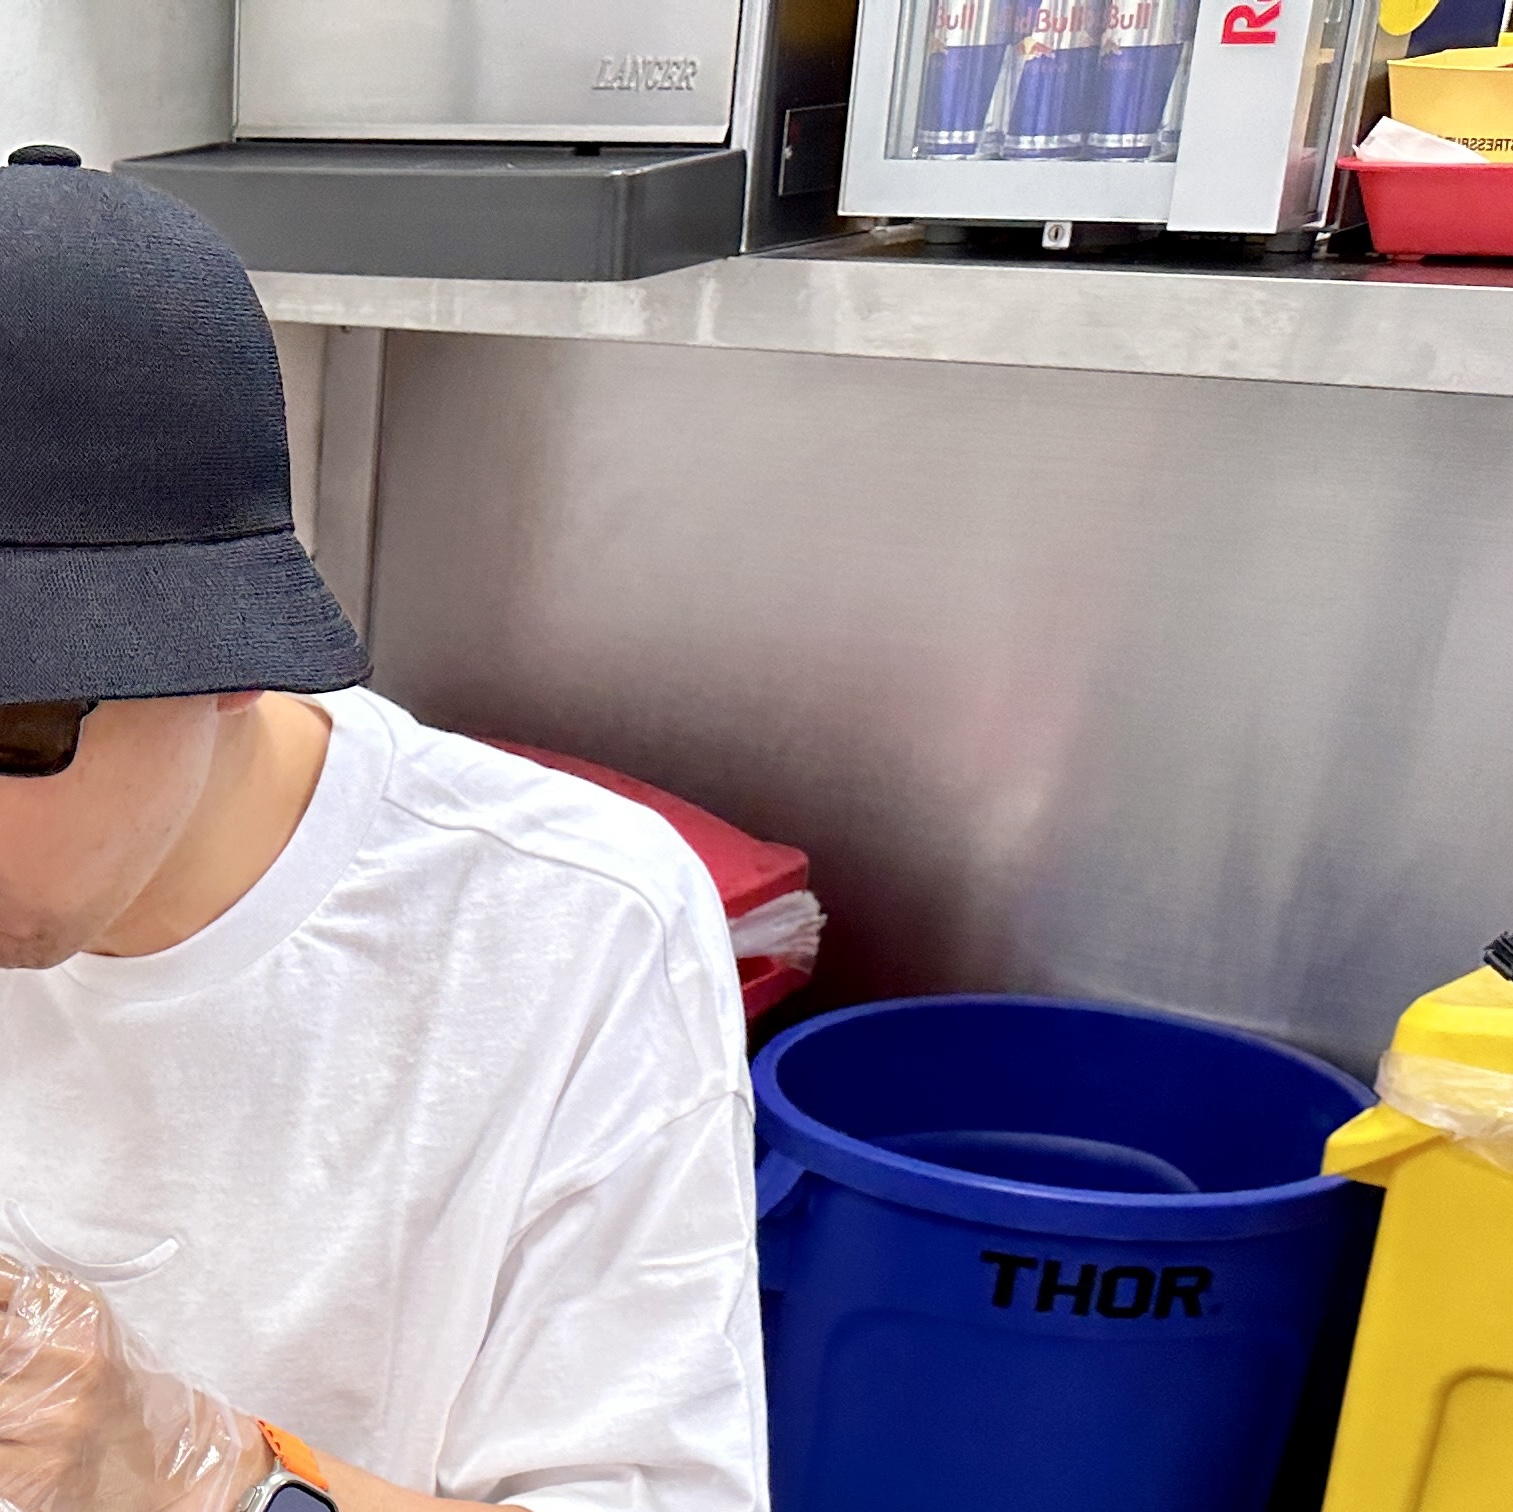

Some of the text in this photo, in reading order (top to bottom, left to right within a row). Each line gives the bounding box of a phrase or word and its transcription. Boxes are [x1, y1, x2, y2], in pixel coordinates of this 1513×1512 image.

[1034, 6, 1085, 34] Bull
[1107, 2, 1152, 30] Bull
[591, 56, 698, 91] LANCER
[980, 1250, 1213, 1319] THOR
